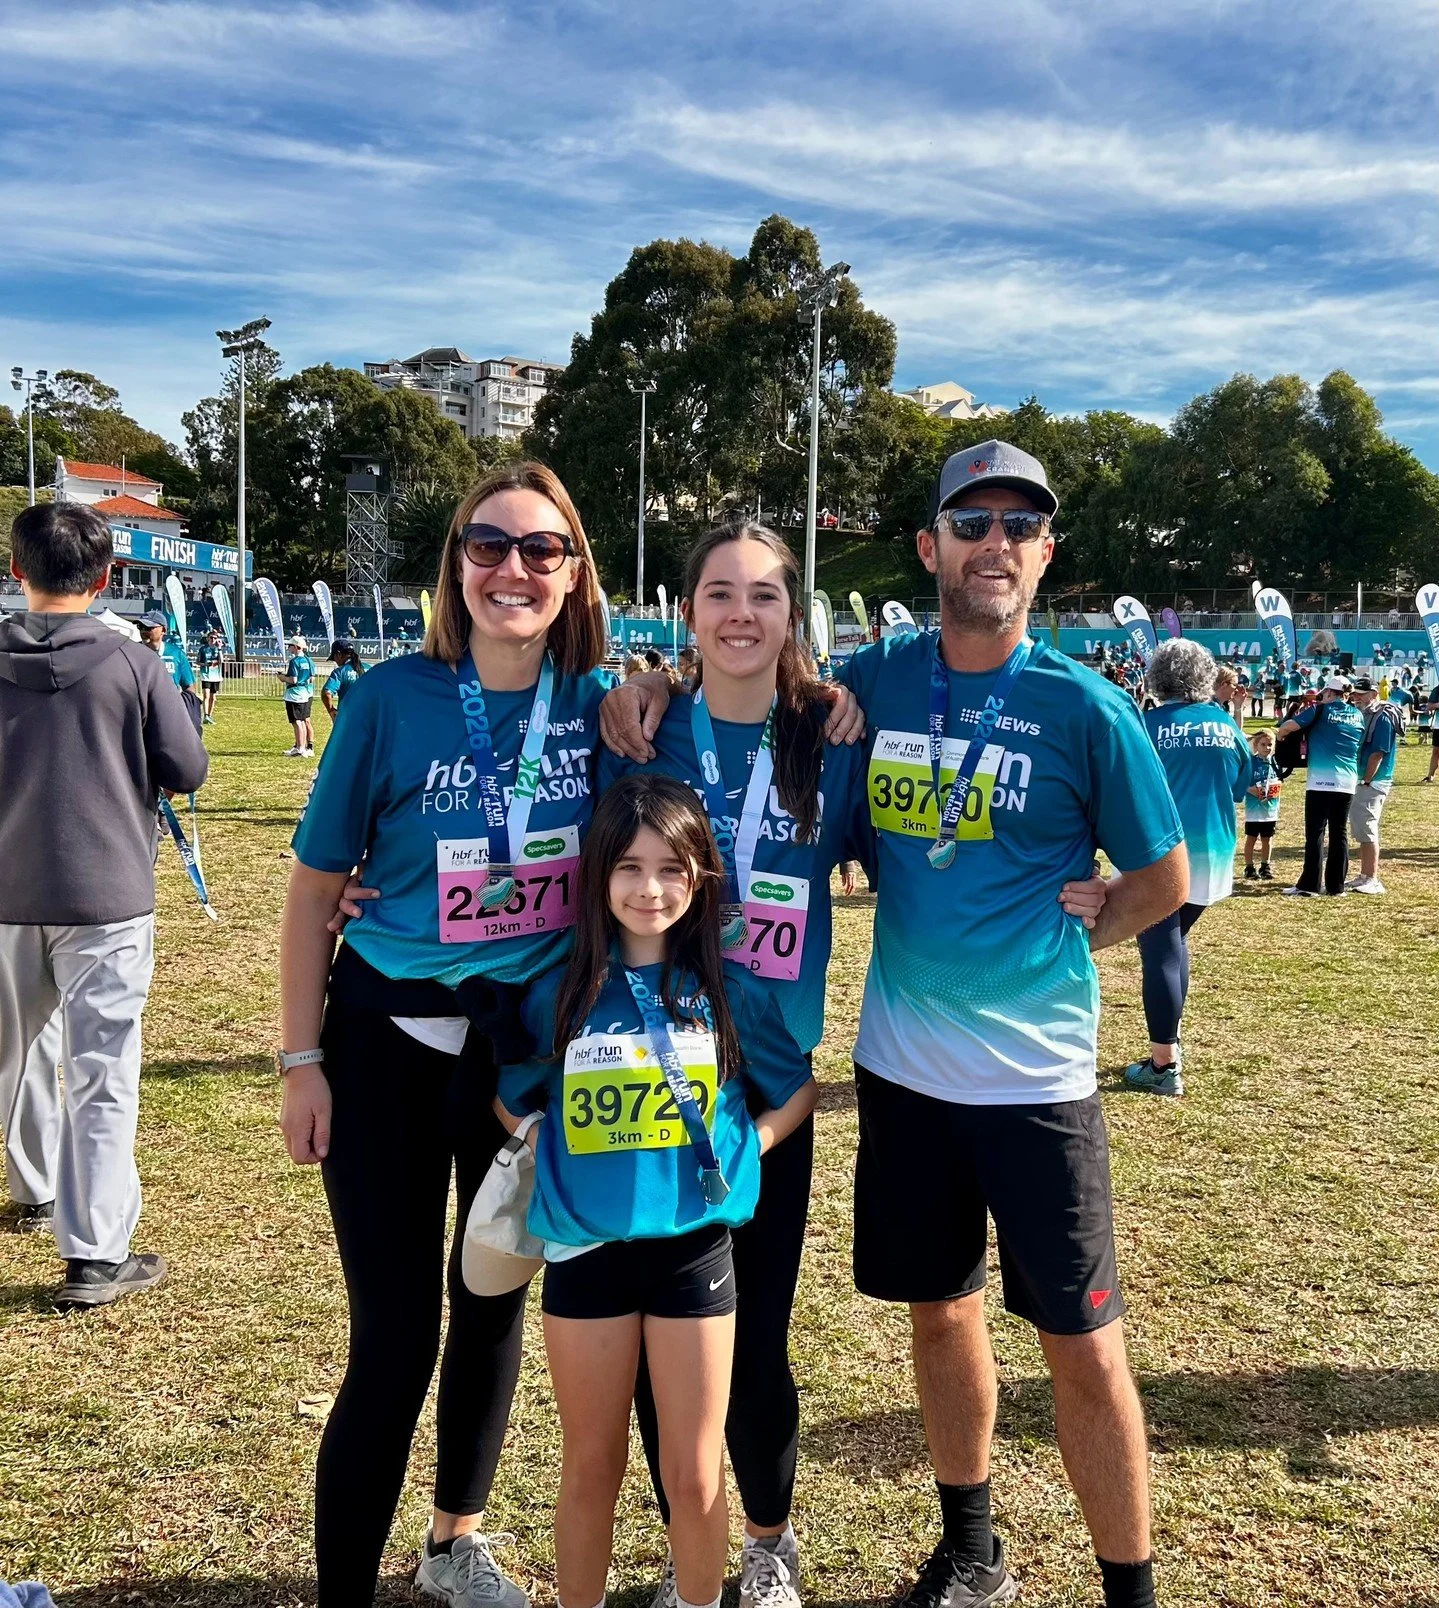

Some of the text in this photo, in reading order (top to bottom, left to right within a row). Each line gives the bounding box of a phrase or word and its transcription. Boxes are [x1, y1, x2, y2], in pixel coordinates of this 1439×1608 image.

[151, 536, 196, 565] FINISH
[1260, 596, 1280, 612] W
[1424, 592, 1437, 608] V
[1121, 602, 1136, 618] X
[360, 644, 378, 654] hbf
[458, 680, 492, 750] 2026
[1157, 721, 1193, 740] hbf
[884, 740, 925, 754] hbf run
[1157, 738, 1180, 750] FOR
[1183, 737, 1192, 748] A
[899, 751, 923, 760] REASON
[514, 755, 542, 799] 12K
[422, 790, 469, 815] FOR
[503, 777, 591, 808] RASON
[483, 797, 495, 827] REASON
[491, 801, 505, 827] run
[943, 794, 956, 821] REASON
[948, 800, 964, 823] run
[901, 818, 927, 832] 3km
[452, 849, 473, 860] hbf
[527, 842, 564, 855] Specsavers
[754, 884, 792, 897] Specsavers
[484, 922, 521, 937] 12km
[535, 916, 546, 928] D
[750, 960, 761, 971] D
[625, 971, 663, 1027] 2026
[574, 1045, 622, 1060] hbf run
[593, 1056, 622, 1064] REASON
[667, 1074, 684, 1105] REASON
[676, 1076, 693, 1103] run
[569, 1079, 709, 1129] 39729
[608, 1131, 642, 1145] 3km
[660, 1128, 671, 1141] D
